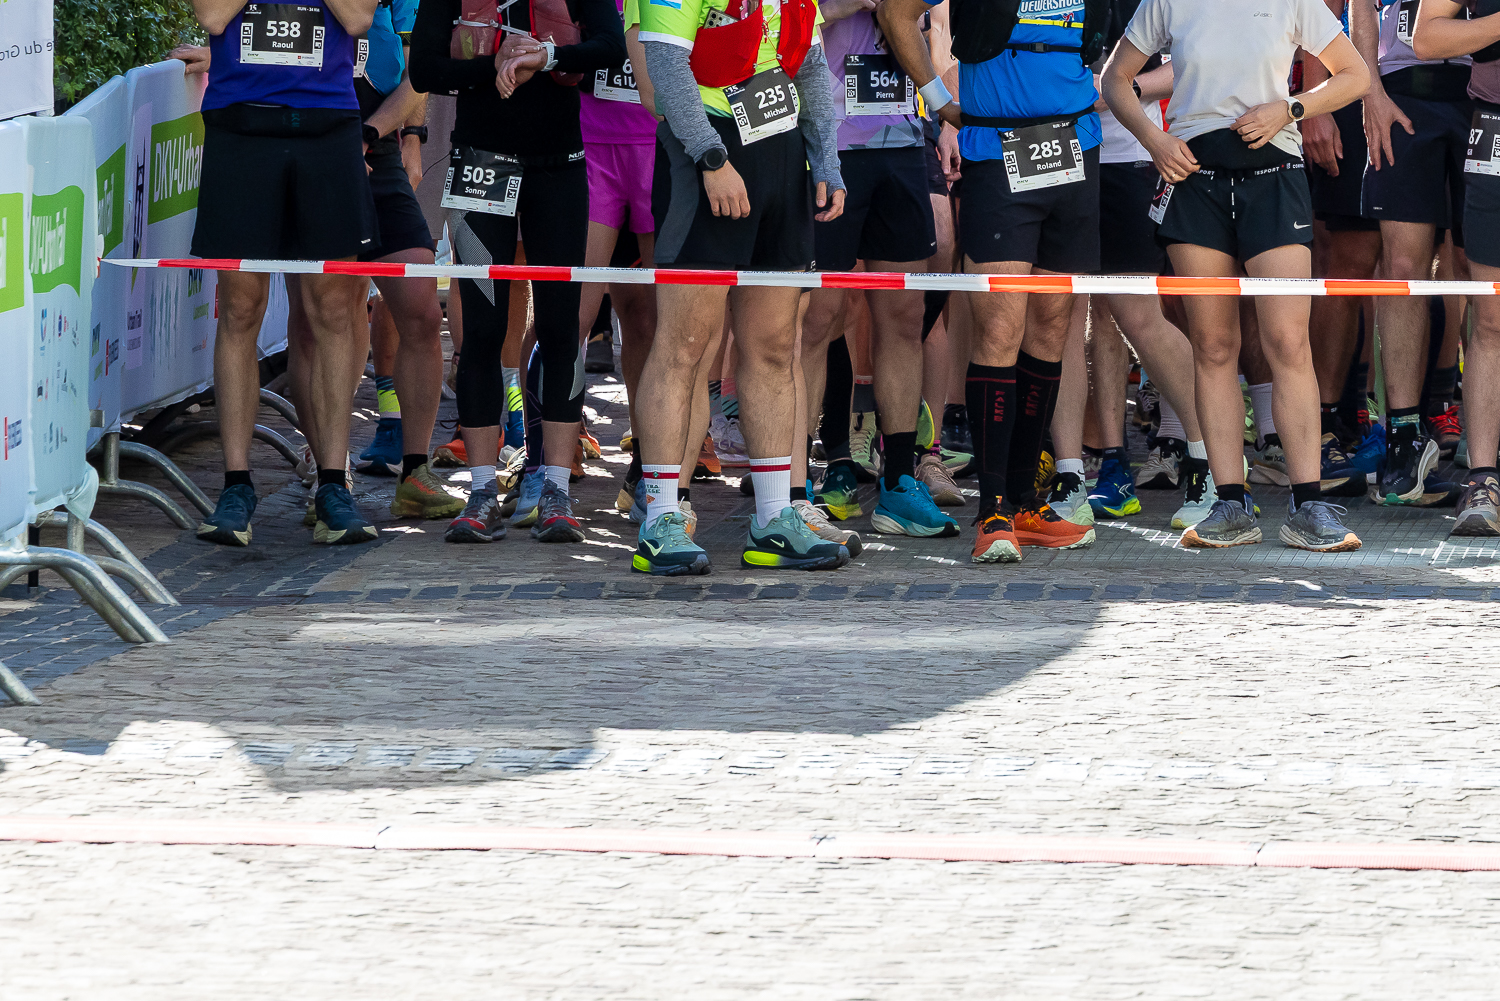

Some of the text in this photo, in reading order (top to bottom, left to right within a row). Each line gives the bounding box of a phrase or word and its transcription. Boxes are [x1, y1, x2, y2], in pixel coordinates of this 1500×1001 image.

[266, 20, 301, 38] 538
[272, 41, 294, 49] Raoul
[869, 70, 899, 88] 564
[754, 84, 786, 110] 235
[875, 91, 895, 99] Pierre
[763, 105, 789, 120] Michael
[1028, 139, 1063, 161] 285
[1036, 160, 1062, 171] Roland
[461, 165, 496, 186] 503
[465, 186, 487, 198] Sonny
